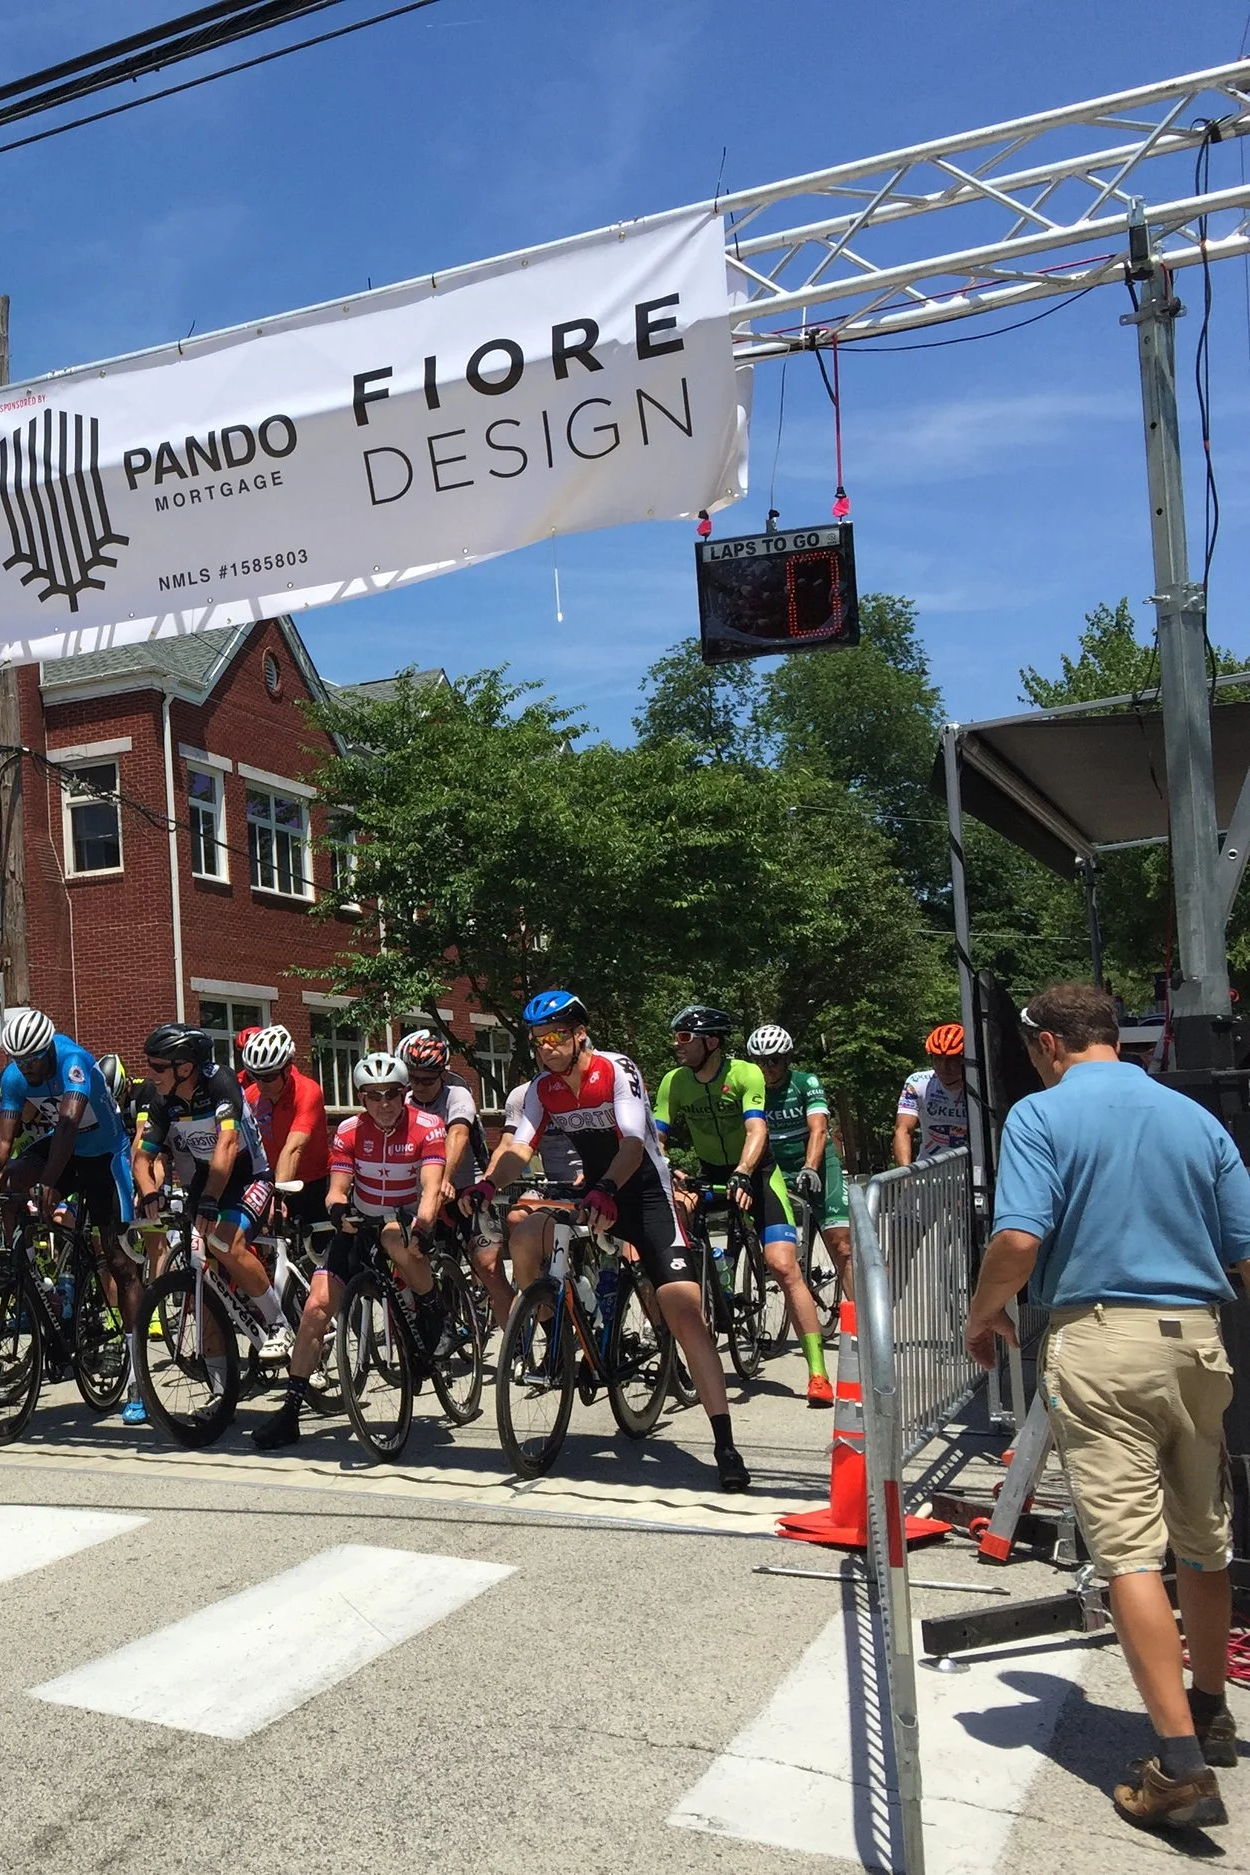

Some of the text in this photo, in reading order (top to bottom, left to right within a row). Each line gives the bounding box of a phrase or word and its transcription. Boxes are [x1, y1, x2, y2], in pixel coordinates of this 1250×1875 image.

[352, 293, 685, 427] FIORE
[0, 396, 36, 413] SPONSORED
[123, 414, 298, 491] PANDO
[363, 377, 694, 506] DESIGN
[154, 470, 285, 513] MORTGAGE
[710, 531, 820, 561] LAPS TO GO
[157, 548, 310, 592] NMLS #1585803
[764, 1106, 804, 1121] KELLY
[938, 1106, 967, 1118] KELL
[394, 1143, 414, 1153] UHC
